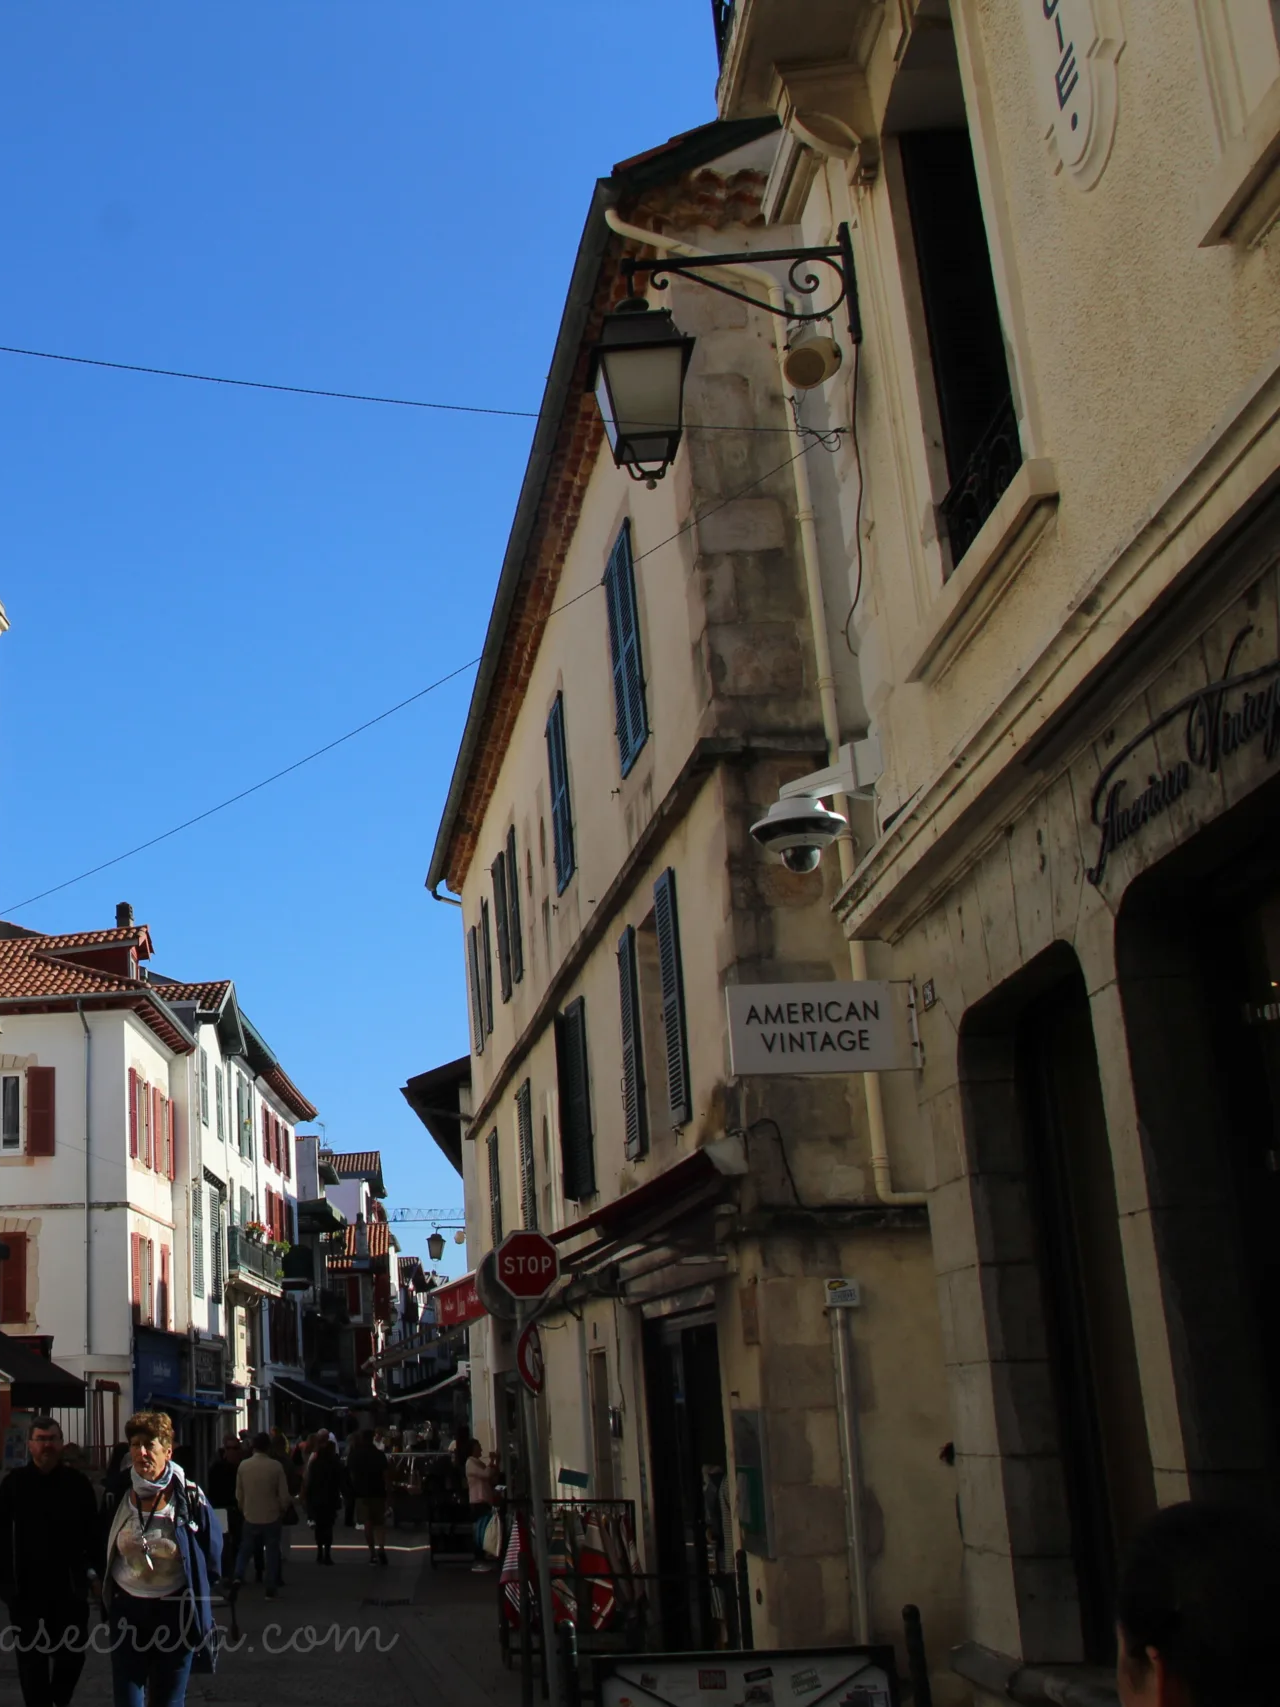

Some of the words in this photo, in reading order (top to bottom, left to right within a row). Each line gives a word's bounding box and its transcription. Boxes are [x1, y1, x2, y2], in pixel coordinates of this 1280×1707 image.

[746, 999, 880, 1026] AMERICAN
[760, 1029, 871, 1053] VINTAGE
[504, 1255, 552, 1275] STOP
